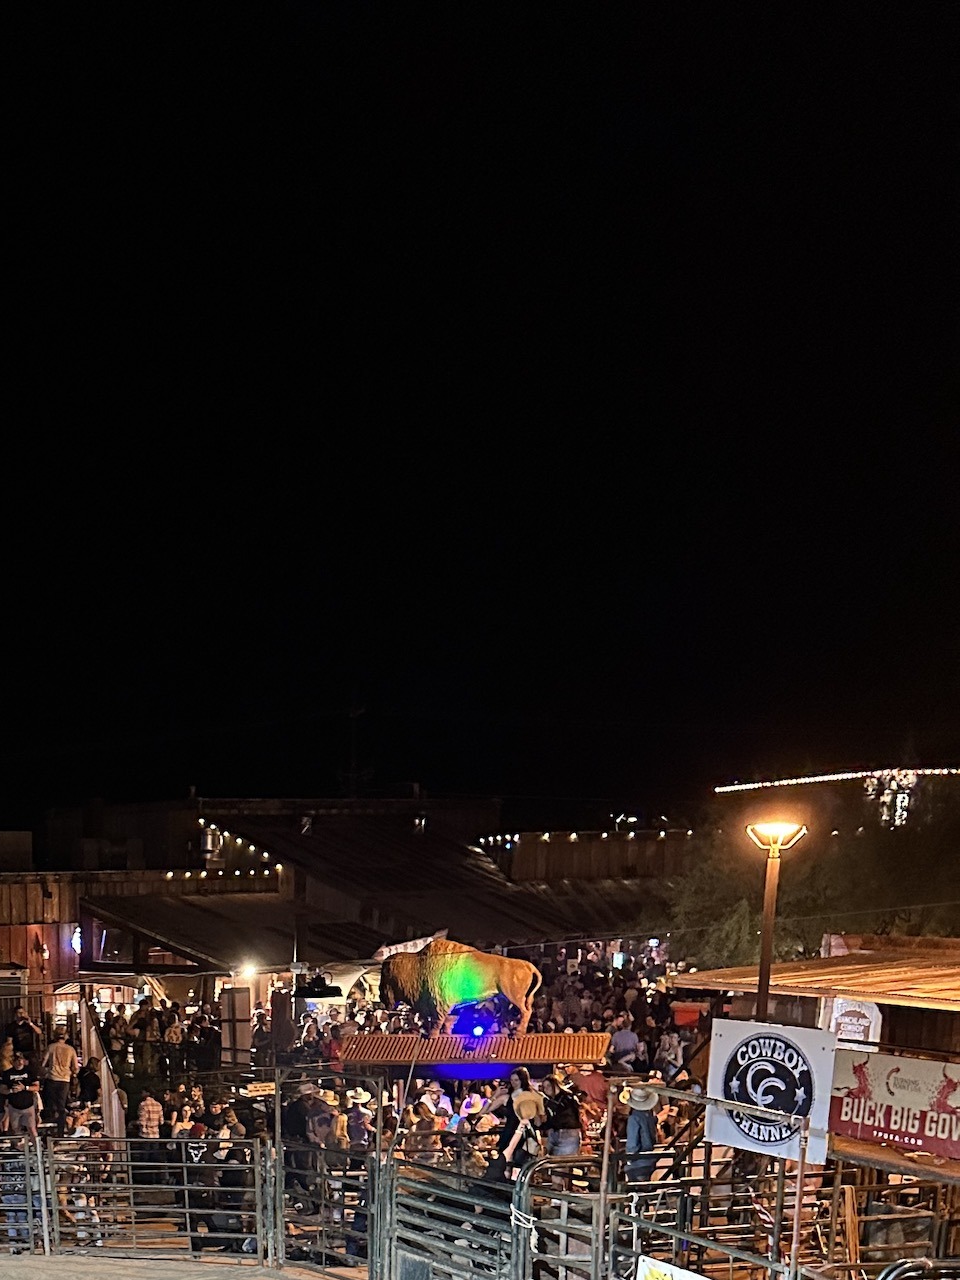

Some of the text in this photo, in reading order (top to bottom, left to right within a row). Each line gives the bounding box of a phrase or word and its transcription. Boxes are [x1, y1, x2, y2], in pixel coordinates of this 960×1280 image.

[736, 1038, 808, 1080] COWBOY
[732, 1110, 798, 1141] CHANNE
[840, 1096, 887, 1128] BUCK
[889, 1105, 921, 1134] BIG
[873, 1129, 923, 1146] TPUSA.COM
